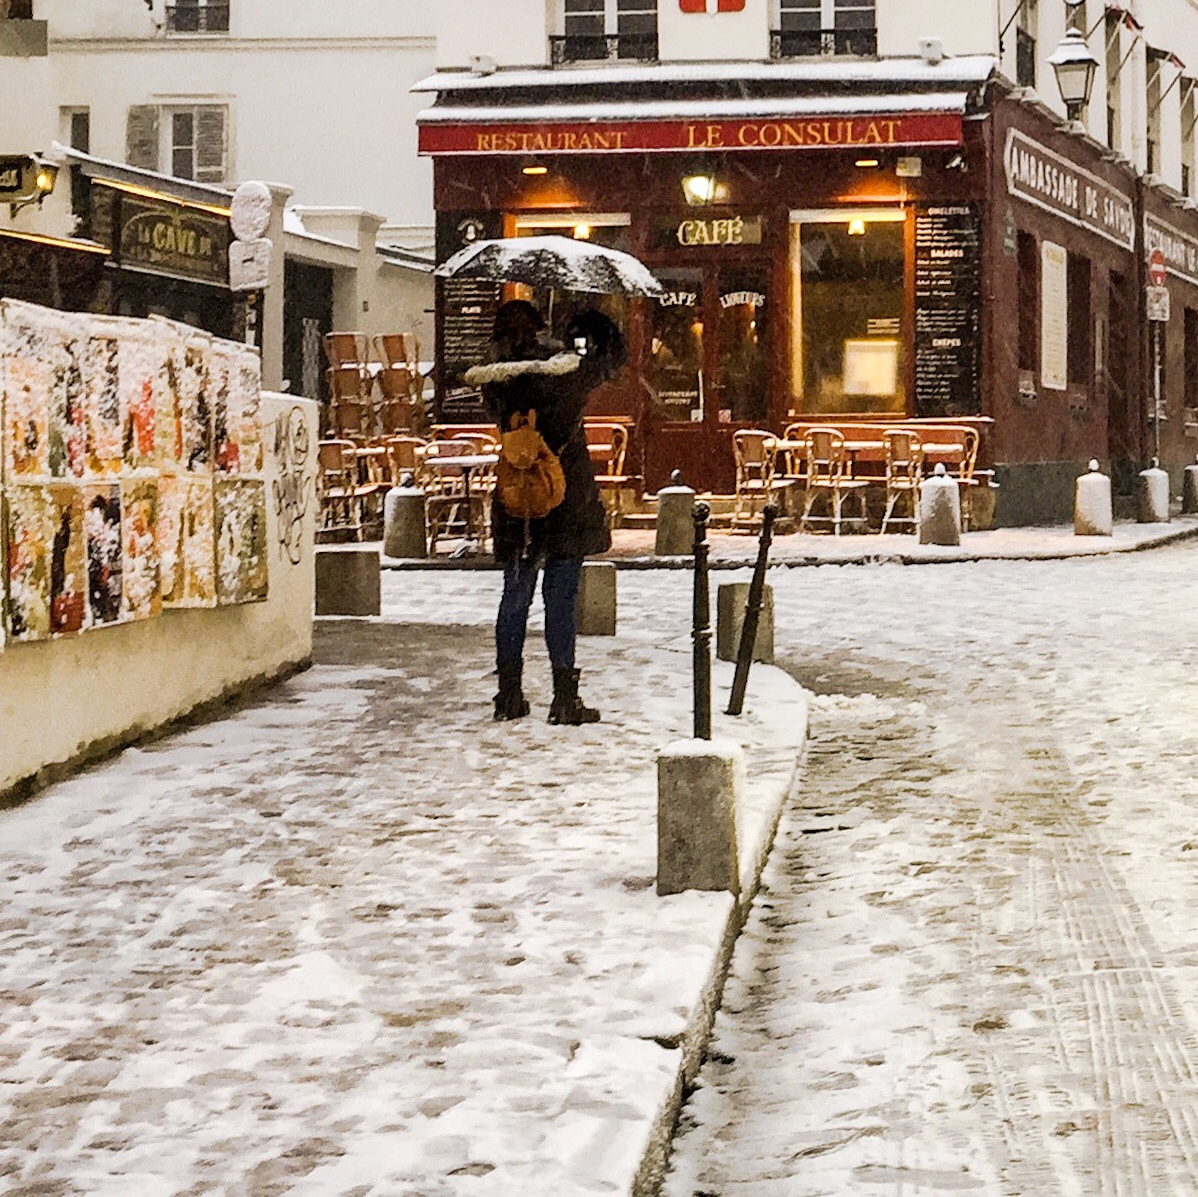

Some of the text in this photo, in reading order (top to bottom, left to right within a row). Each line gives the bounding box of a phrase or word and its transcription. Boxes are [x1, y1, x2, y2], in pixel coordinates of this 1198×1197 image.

[476, 120, 902, 151] RESTAURANT LE CONSULAT
[1011, 146, 1078, 210] AMBASSADE
[1085, 186, 1098, 219] DE
[676, 216, 744, 246] CAFÉ
